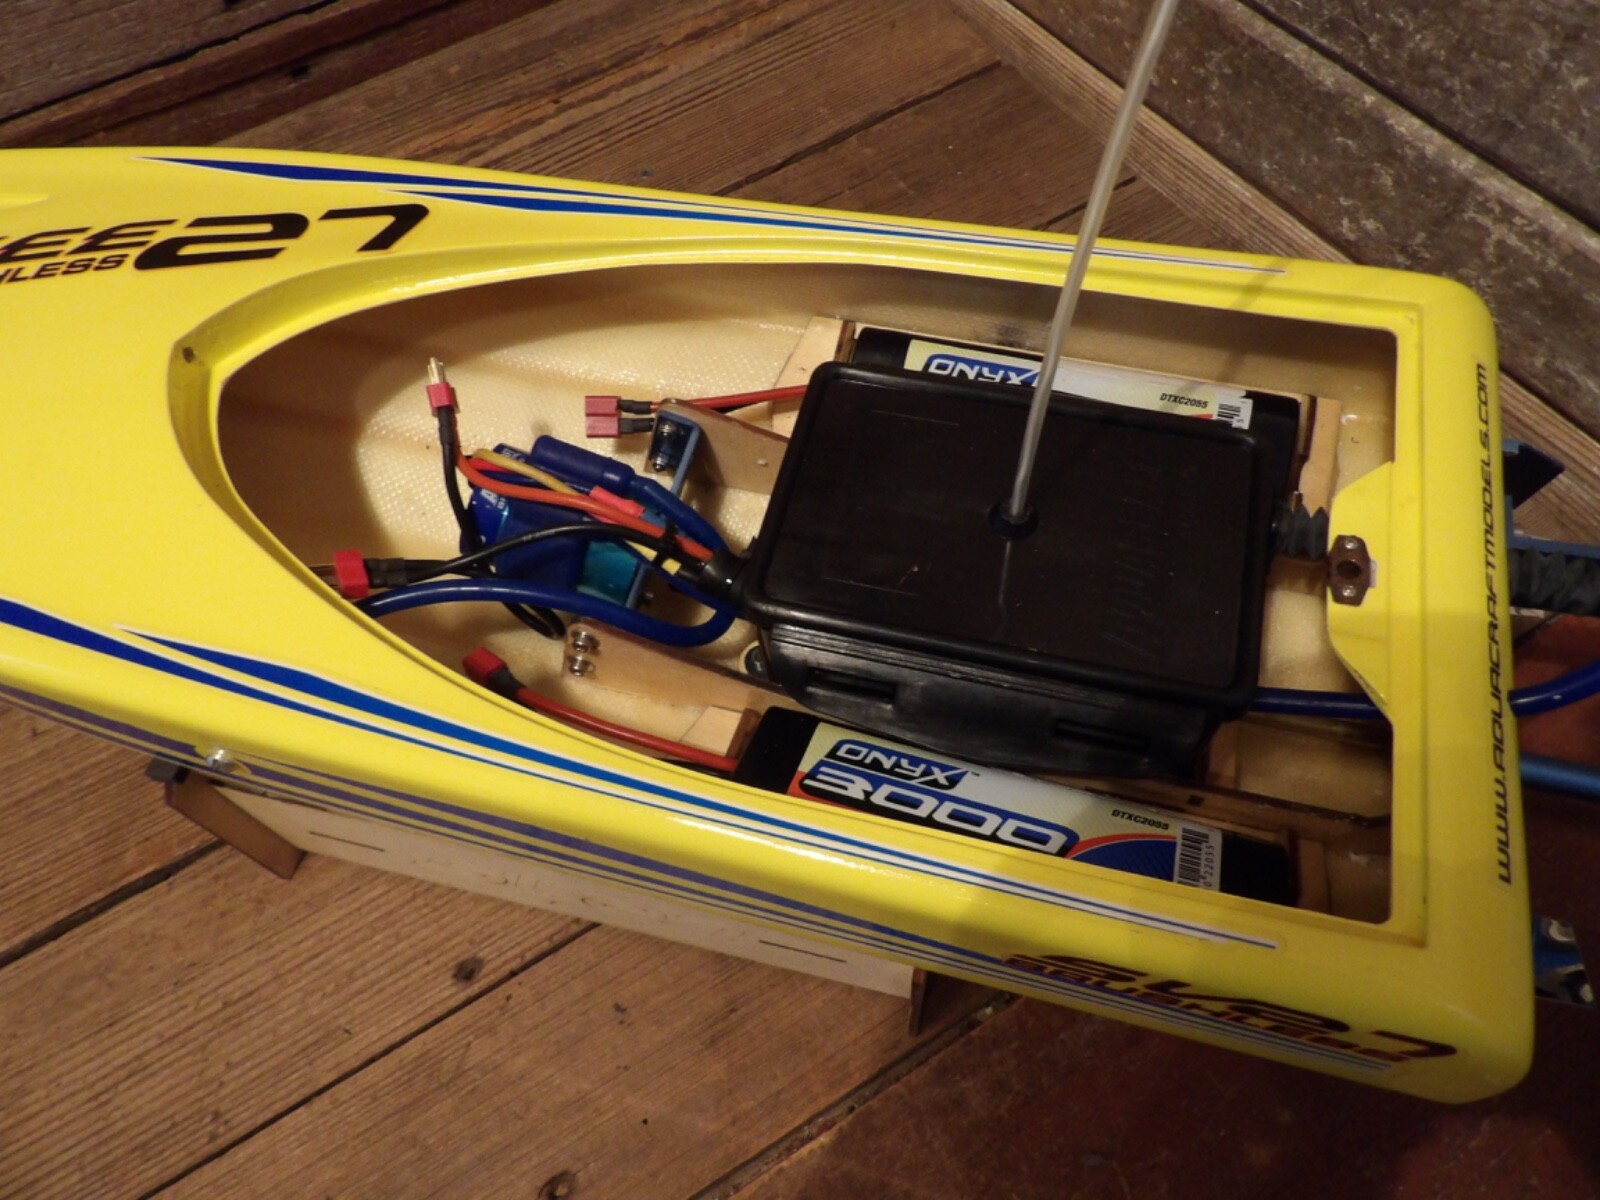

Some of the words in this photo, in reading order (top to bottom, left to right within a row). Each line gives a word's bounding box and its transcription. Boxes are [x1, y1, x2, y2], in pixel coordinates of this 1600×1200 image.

[133, 203, 430, 270] 27
[927, 358, 1040, 386] ONYX
[1160, 392, 1209, 409] DTXC2055
[836, 743, 965, 787] ONYX
[802, 765, 1068, 855] 3000
[1111, 809, 1170, 831] DTXC2055
